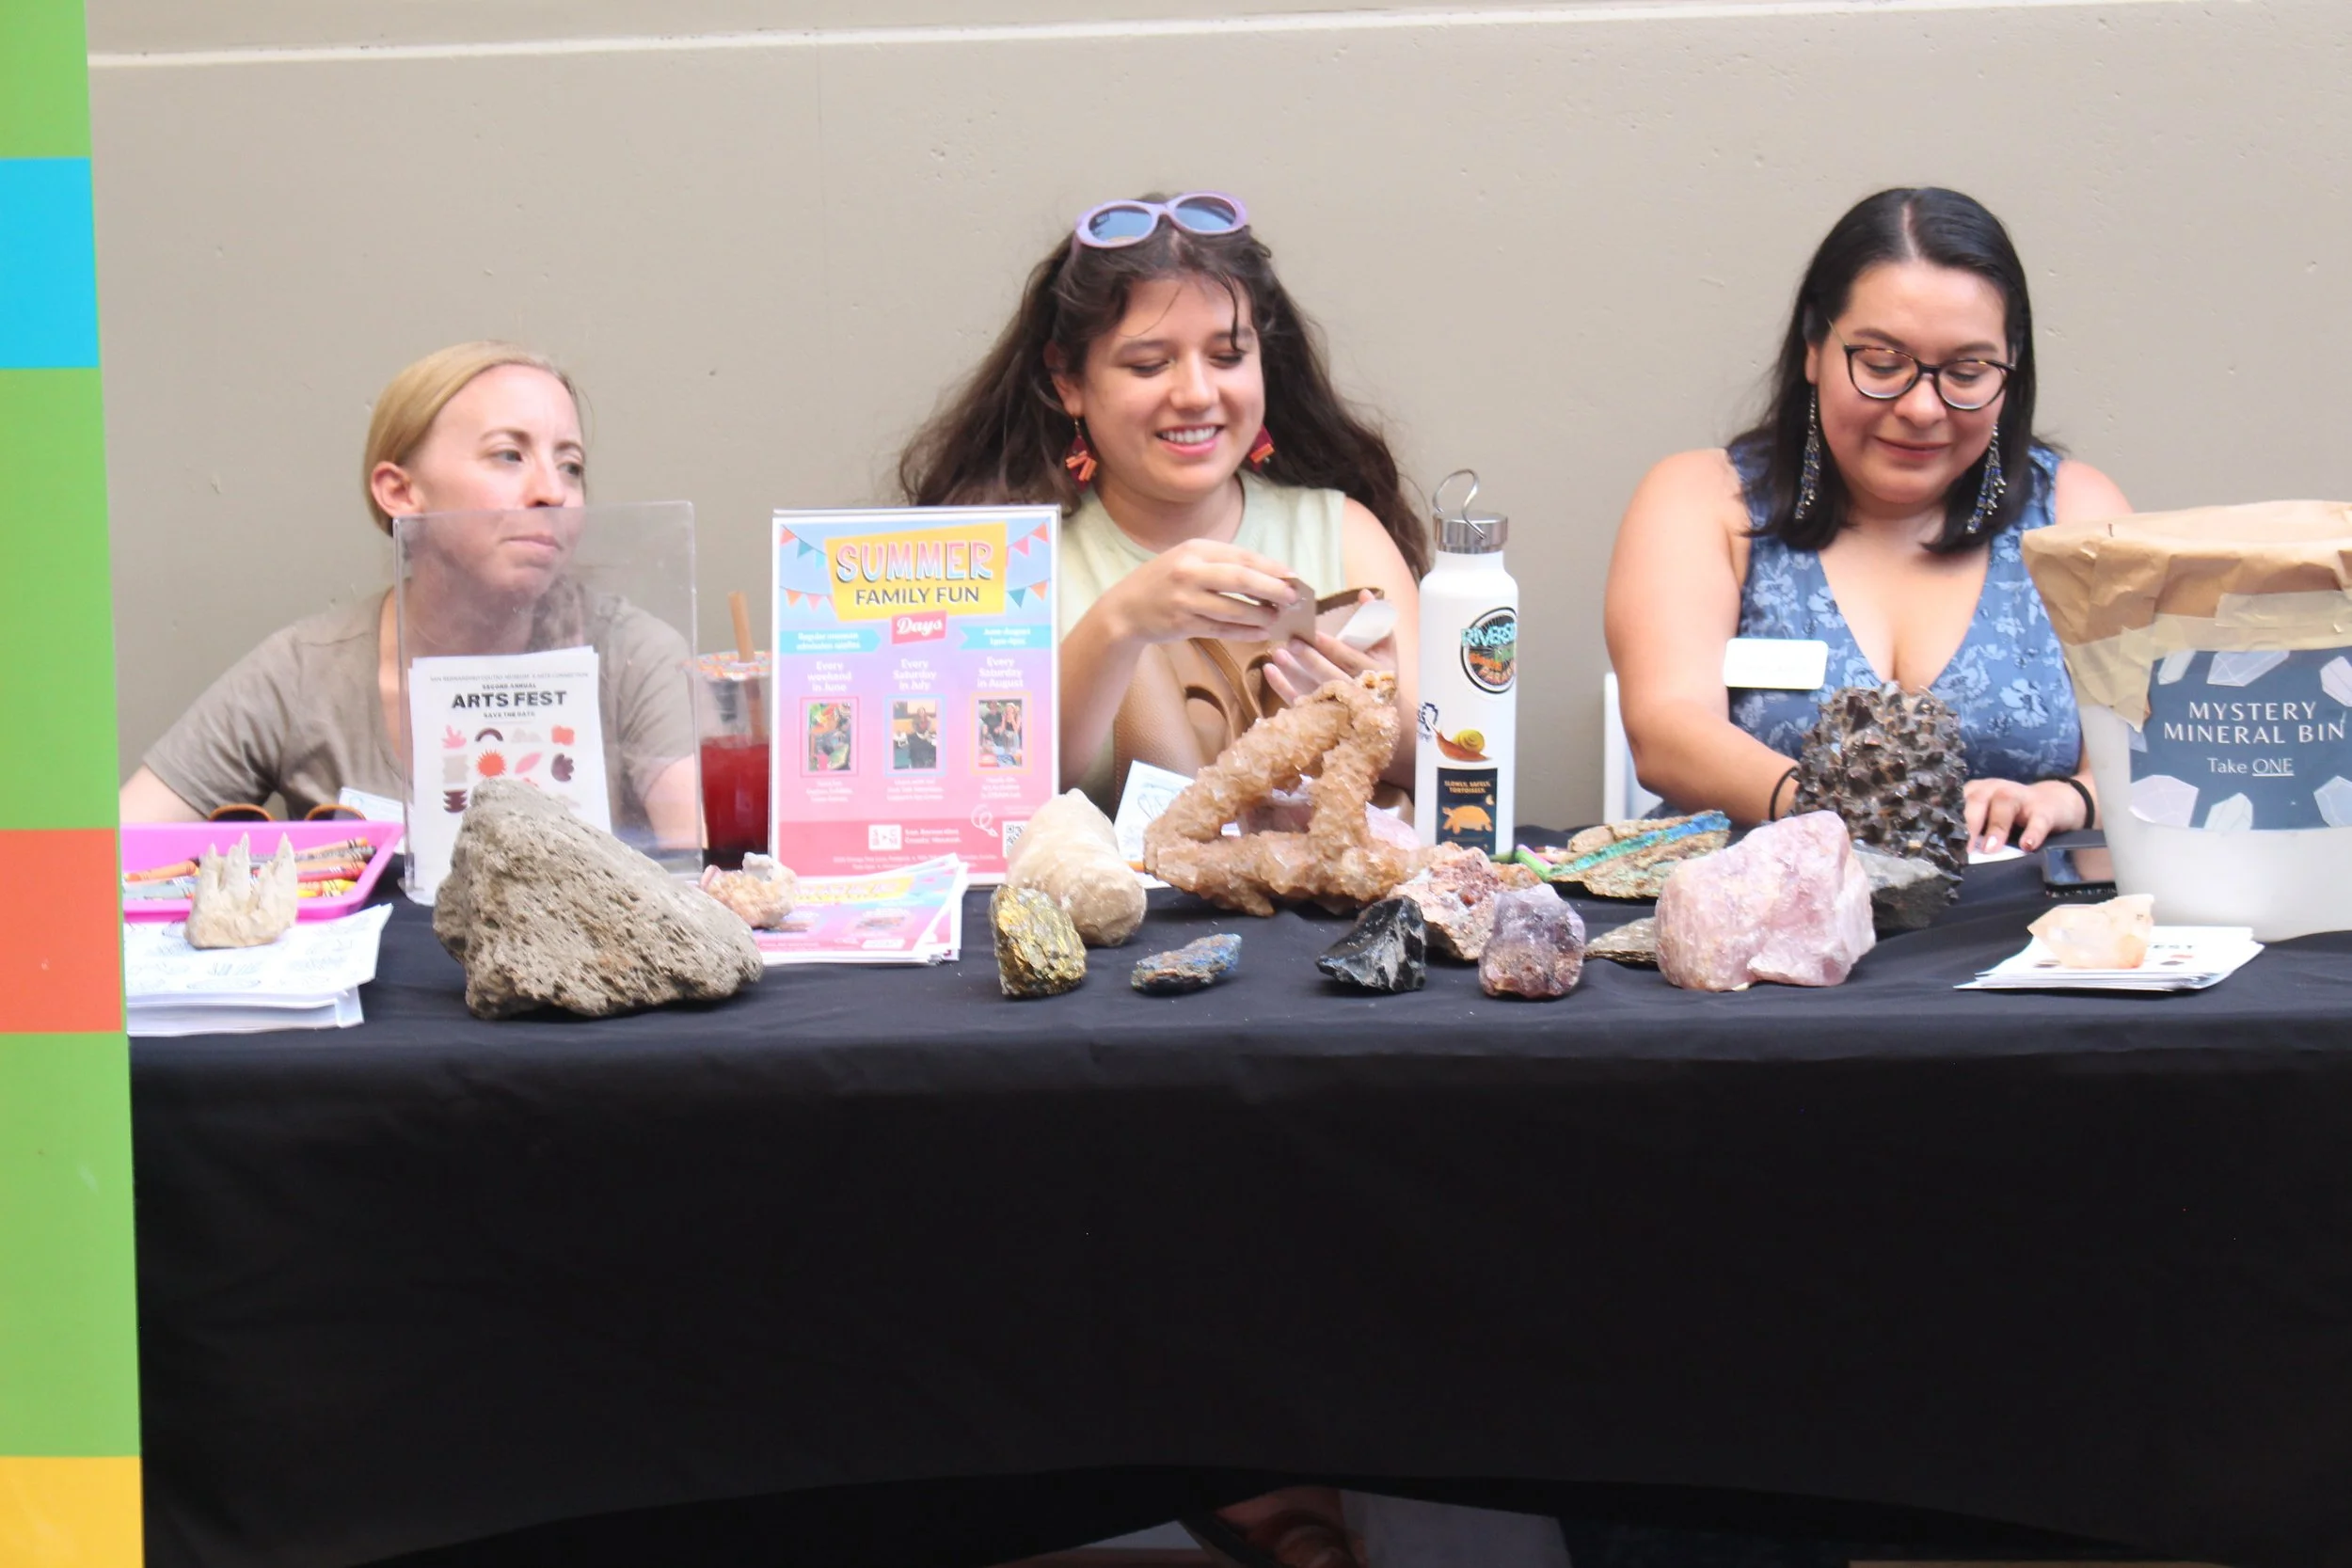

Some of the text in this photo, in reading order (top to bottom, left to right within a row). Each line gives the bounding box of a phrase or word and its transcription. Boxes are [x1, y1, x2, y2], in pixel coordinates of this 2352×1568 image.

[835, 541, 993, 584] SUMMER
[854, 586, 979, 606] FAMILY FUN
[896, 616, 944, 637] Days
[816, 660, 844, 672] Every
[900, 658, 929, 670] Every
[987, 656, 1015, 667] Every
[807, 671, 852, 682] weekend
[893, 670, 937, 680] Saturday
[978, 667, 1024, 678] Saturday
[812, 682, 848, 693] in June
[899, 680, 931, 691] in July
[977, 677, 1025, 689] in August
[451, 690, 567, 709] ARTS FEST
[2188, 701, 2317, 721] MYSTERY
[2164, 722, 2345, 745] MINERAL BIN
[2207, 757, 2295, 776] Take ONE
